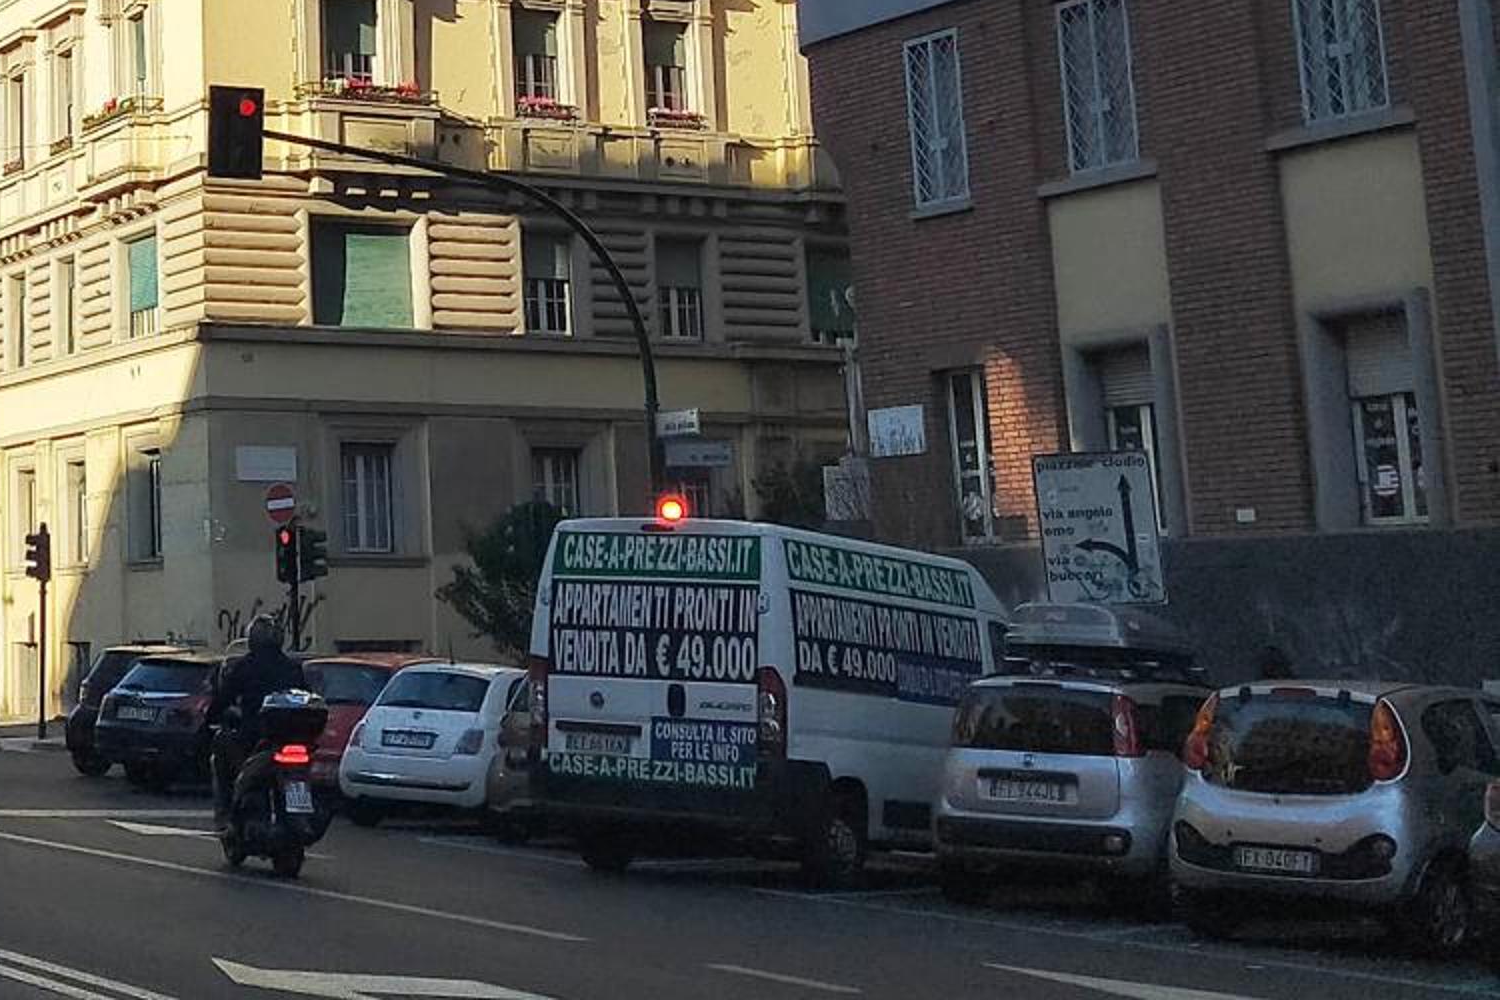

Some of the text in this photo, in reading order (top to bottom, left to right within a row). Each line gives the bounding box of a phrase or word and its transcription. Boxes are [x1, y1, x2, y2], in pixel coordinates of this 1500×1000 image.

[1043, 506, 1113, 521] via angelo
[1044, 526, 1075, 537] emo
[564, 535, 754, 573] CASE-A-PREZZI-BASSI.IT
[1048, 554, 1071, 566] via
[786, 541, 974, 607] CASE-A-PREZZI-BASSI.IT
[553, 583, 757, 633] APPARTAMENTI PRONTI IN
[794, 592, 981, 663] APPARTAMENTI PRONTI IN VENDITA
[553, 629, 756, 681] VENDITA DA € 49.000
[799, 641, 823, 673] DA
[827, 645, 838, 676] €
[841, 647, 896, 683] 49.000
[655, 722, 757, 745] CONSULTA IL SITO
[671, 741, 740, 763] PER LE INFO
[549, 754, 757, 789] CASE-A-PREZZI-BASSI.IT
